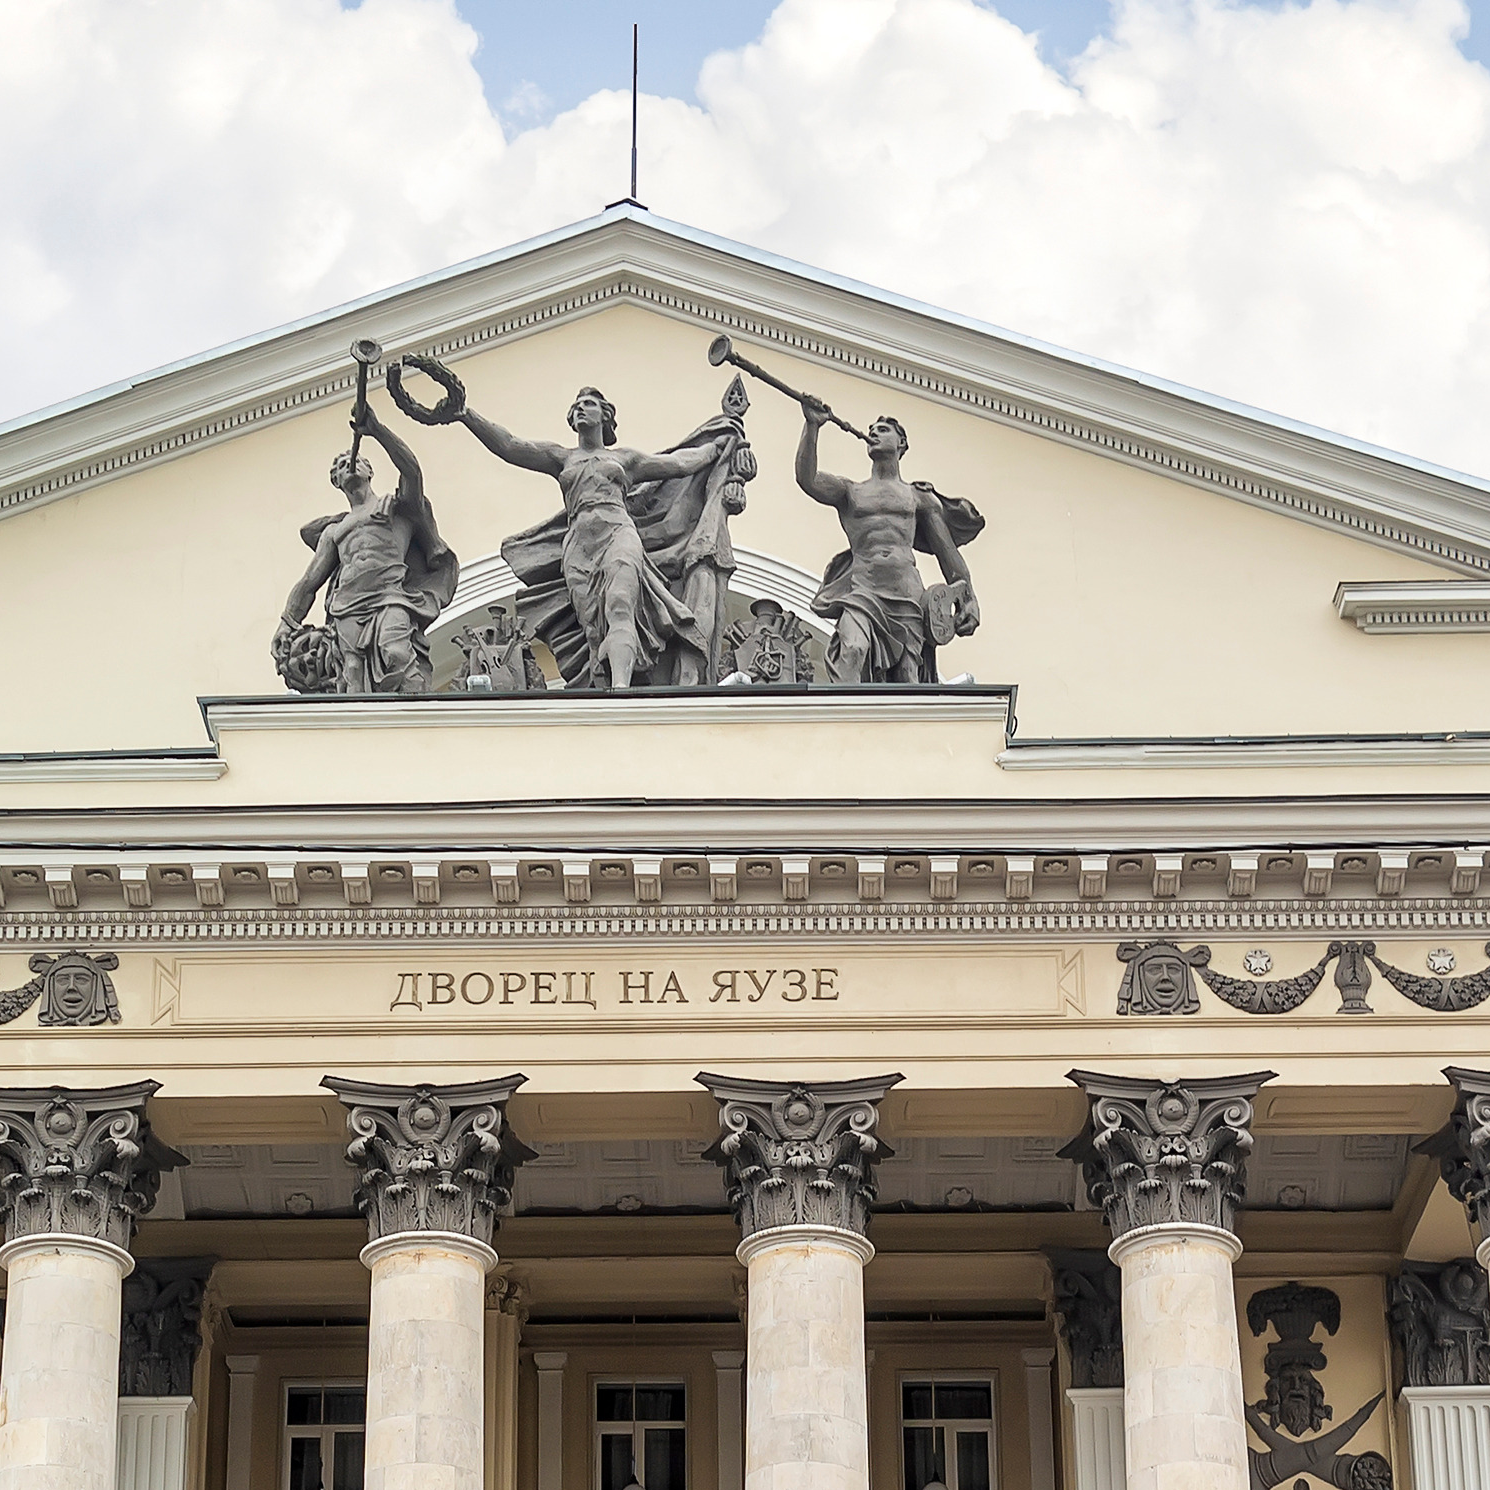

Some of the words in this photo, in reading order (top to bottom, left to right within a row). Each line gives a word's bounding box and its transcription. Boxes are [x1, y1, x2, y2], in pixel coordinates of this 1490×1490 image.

[389, 971, 597, 1012] ДВОРЕЦ
[618, 969, 689, 1005] НА
[708, 967, 841, 1003] ЯУЗЕ
